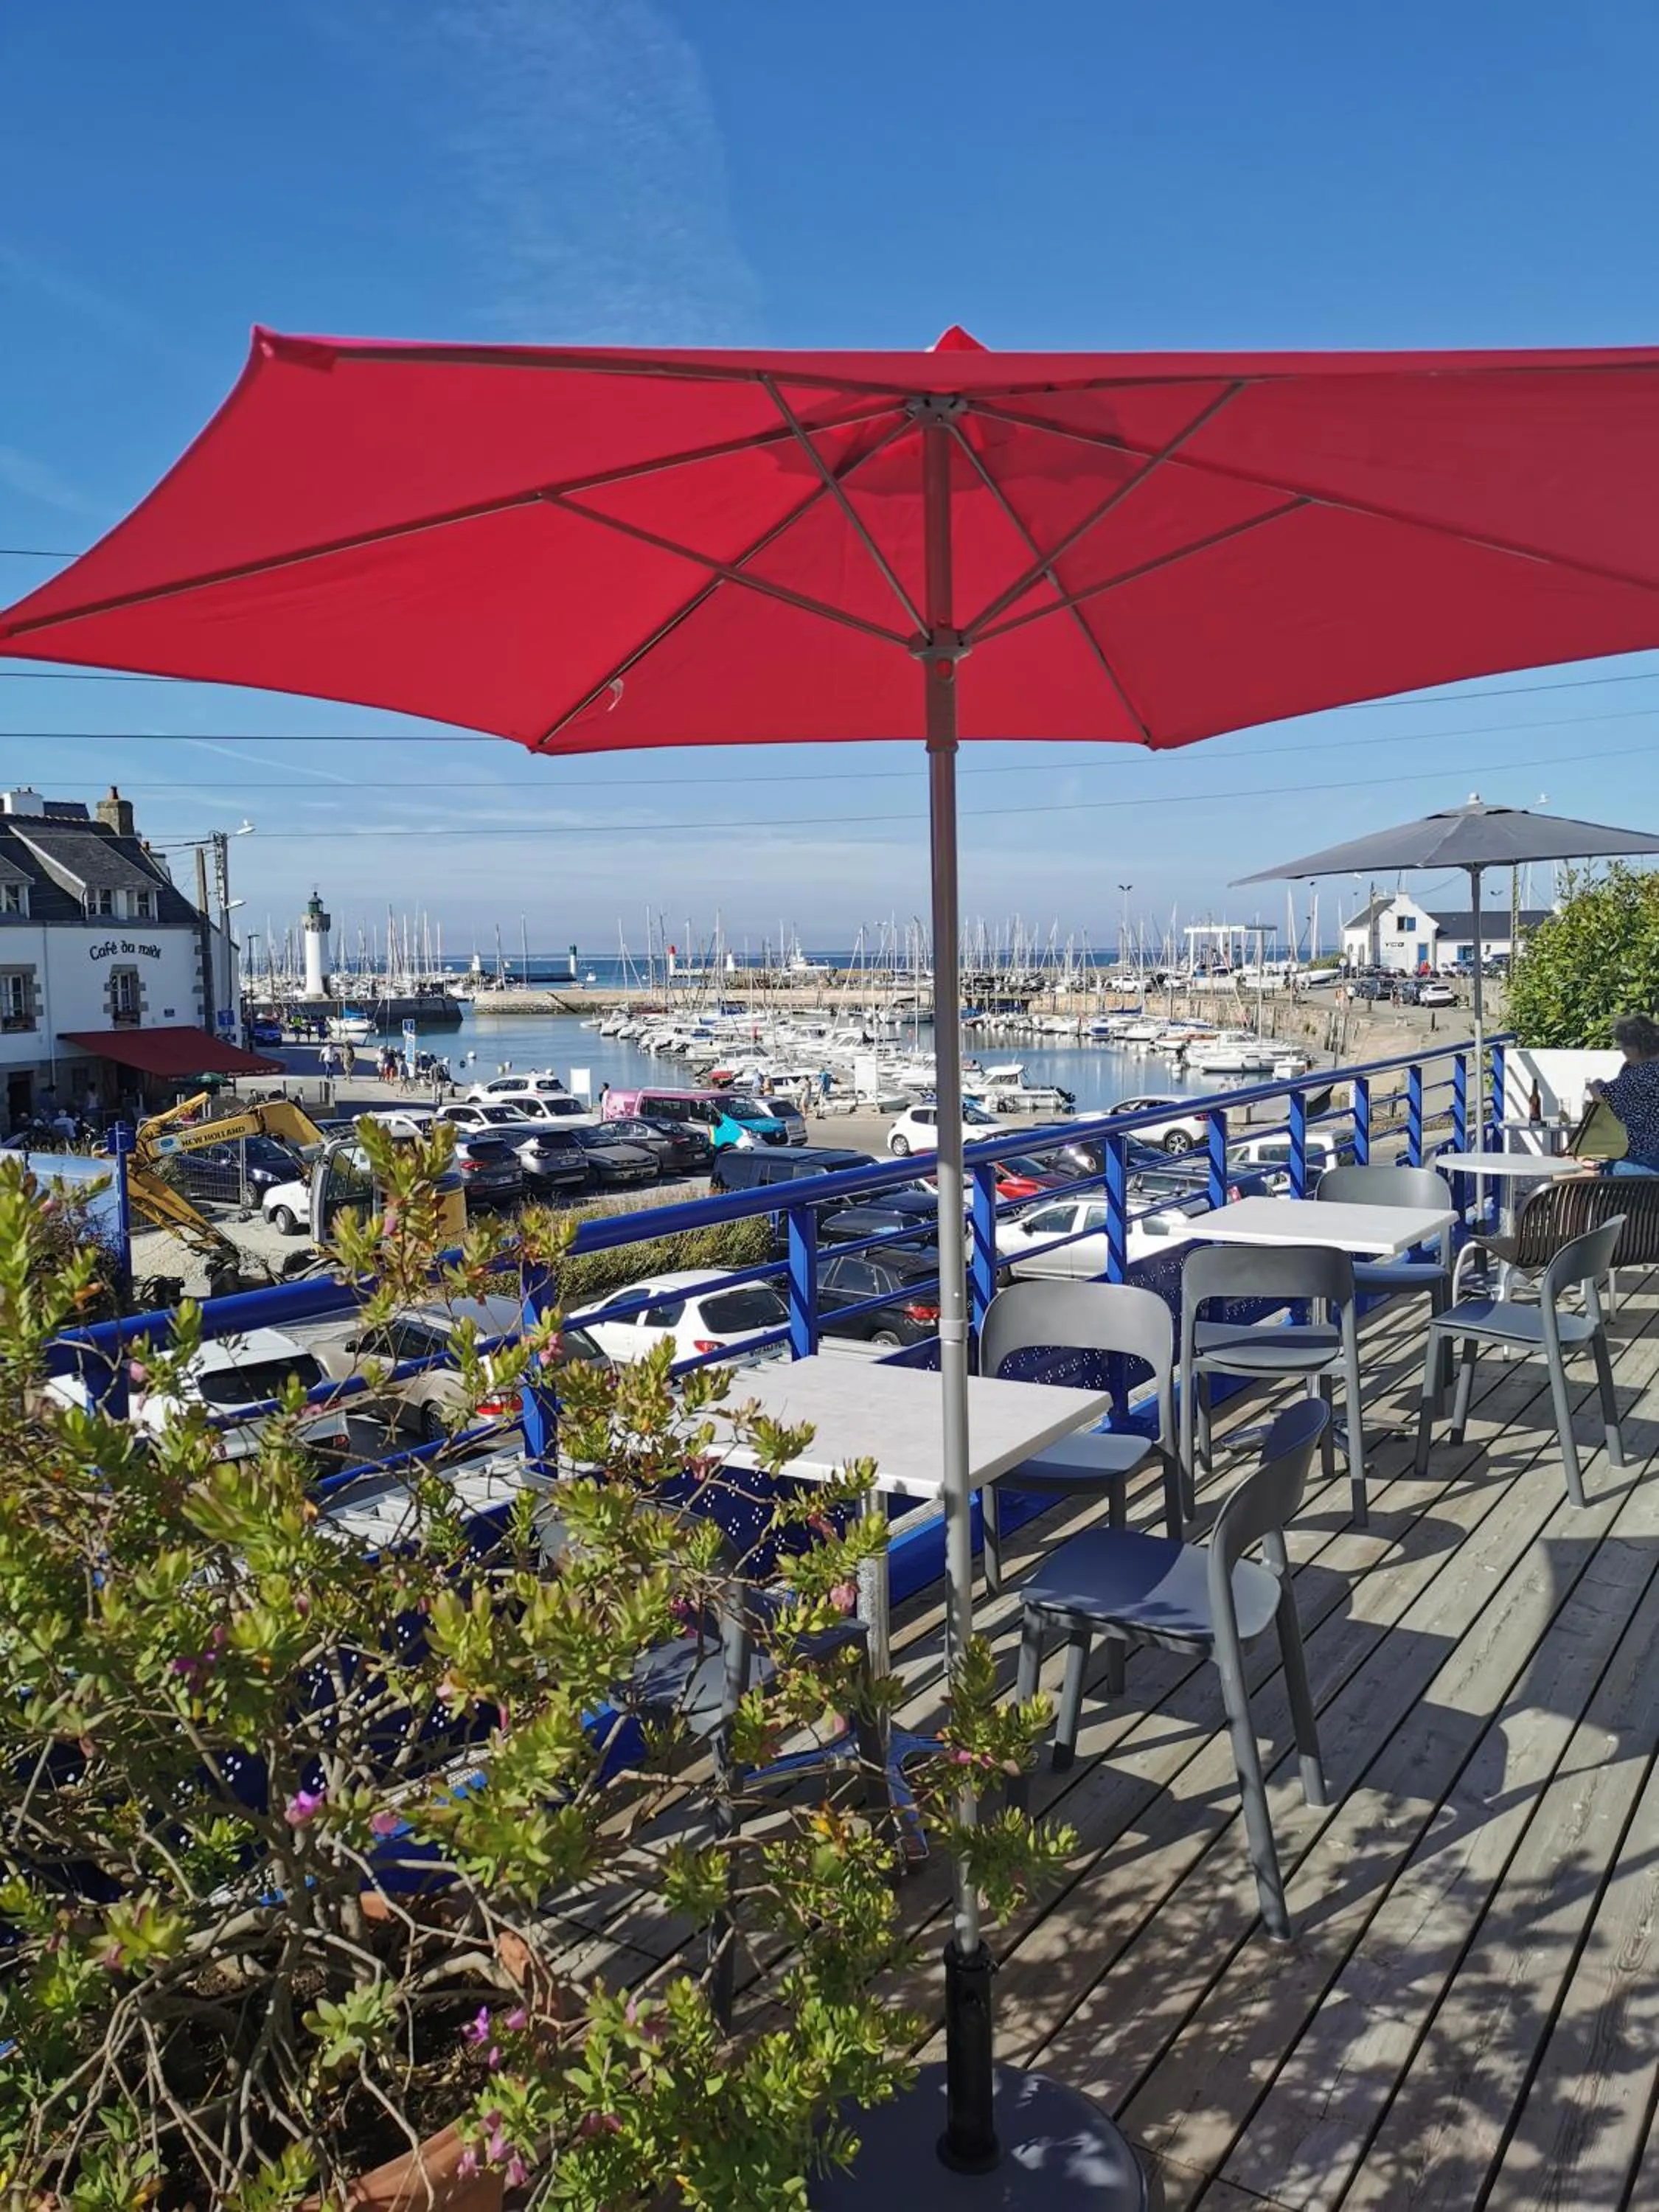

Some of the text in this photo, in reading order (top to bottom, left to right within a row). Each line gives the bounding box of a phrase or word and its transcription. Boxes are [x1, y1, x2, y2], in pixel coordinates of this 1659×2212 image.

[89, 941, 118, 961] Café
[181, 1126, 246, 1147] NEW HOLLAND
